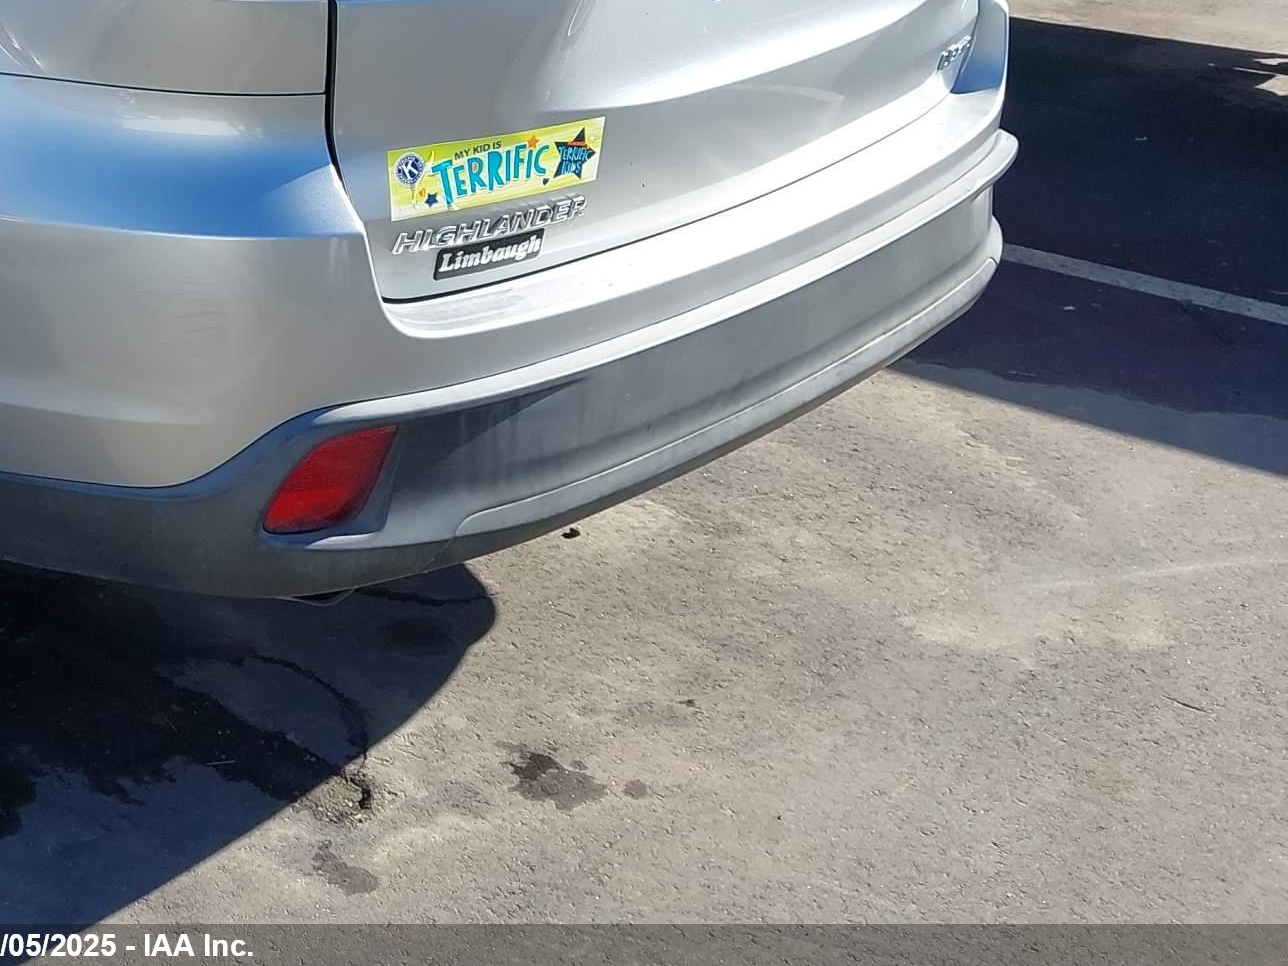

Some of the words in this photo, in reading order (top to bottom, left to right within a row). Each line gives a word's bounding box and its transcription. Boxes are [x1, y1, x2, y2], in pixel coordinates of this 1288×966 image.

[431, 143, 550, 206] TERRIFIC
[454, 148, 470, 160] MY
[472, 143, 491, 156] KID
[492, 140, 502, 150] IS
[391, 194, 588, 255] HIGHLANDER
[438, 234, 542, 273] Limbaugh
